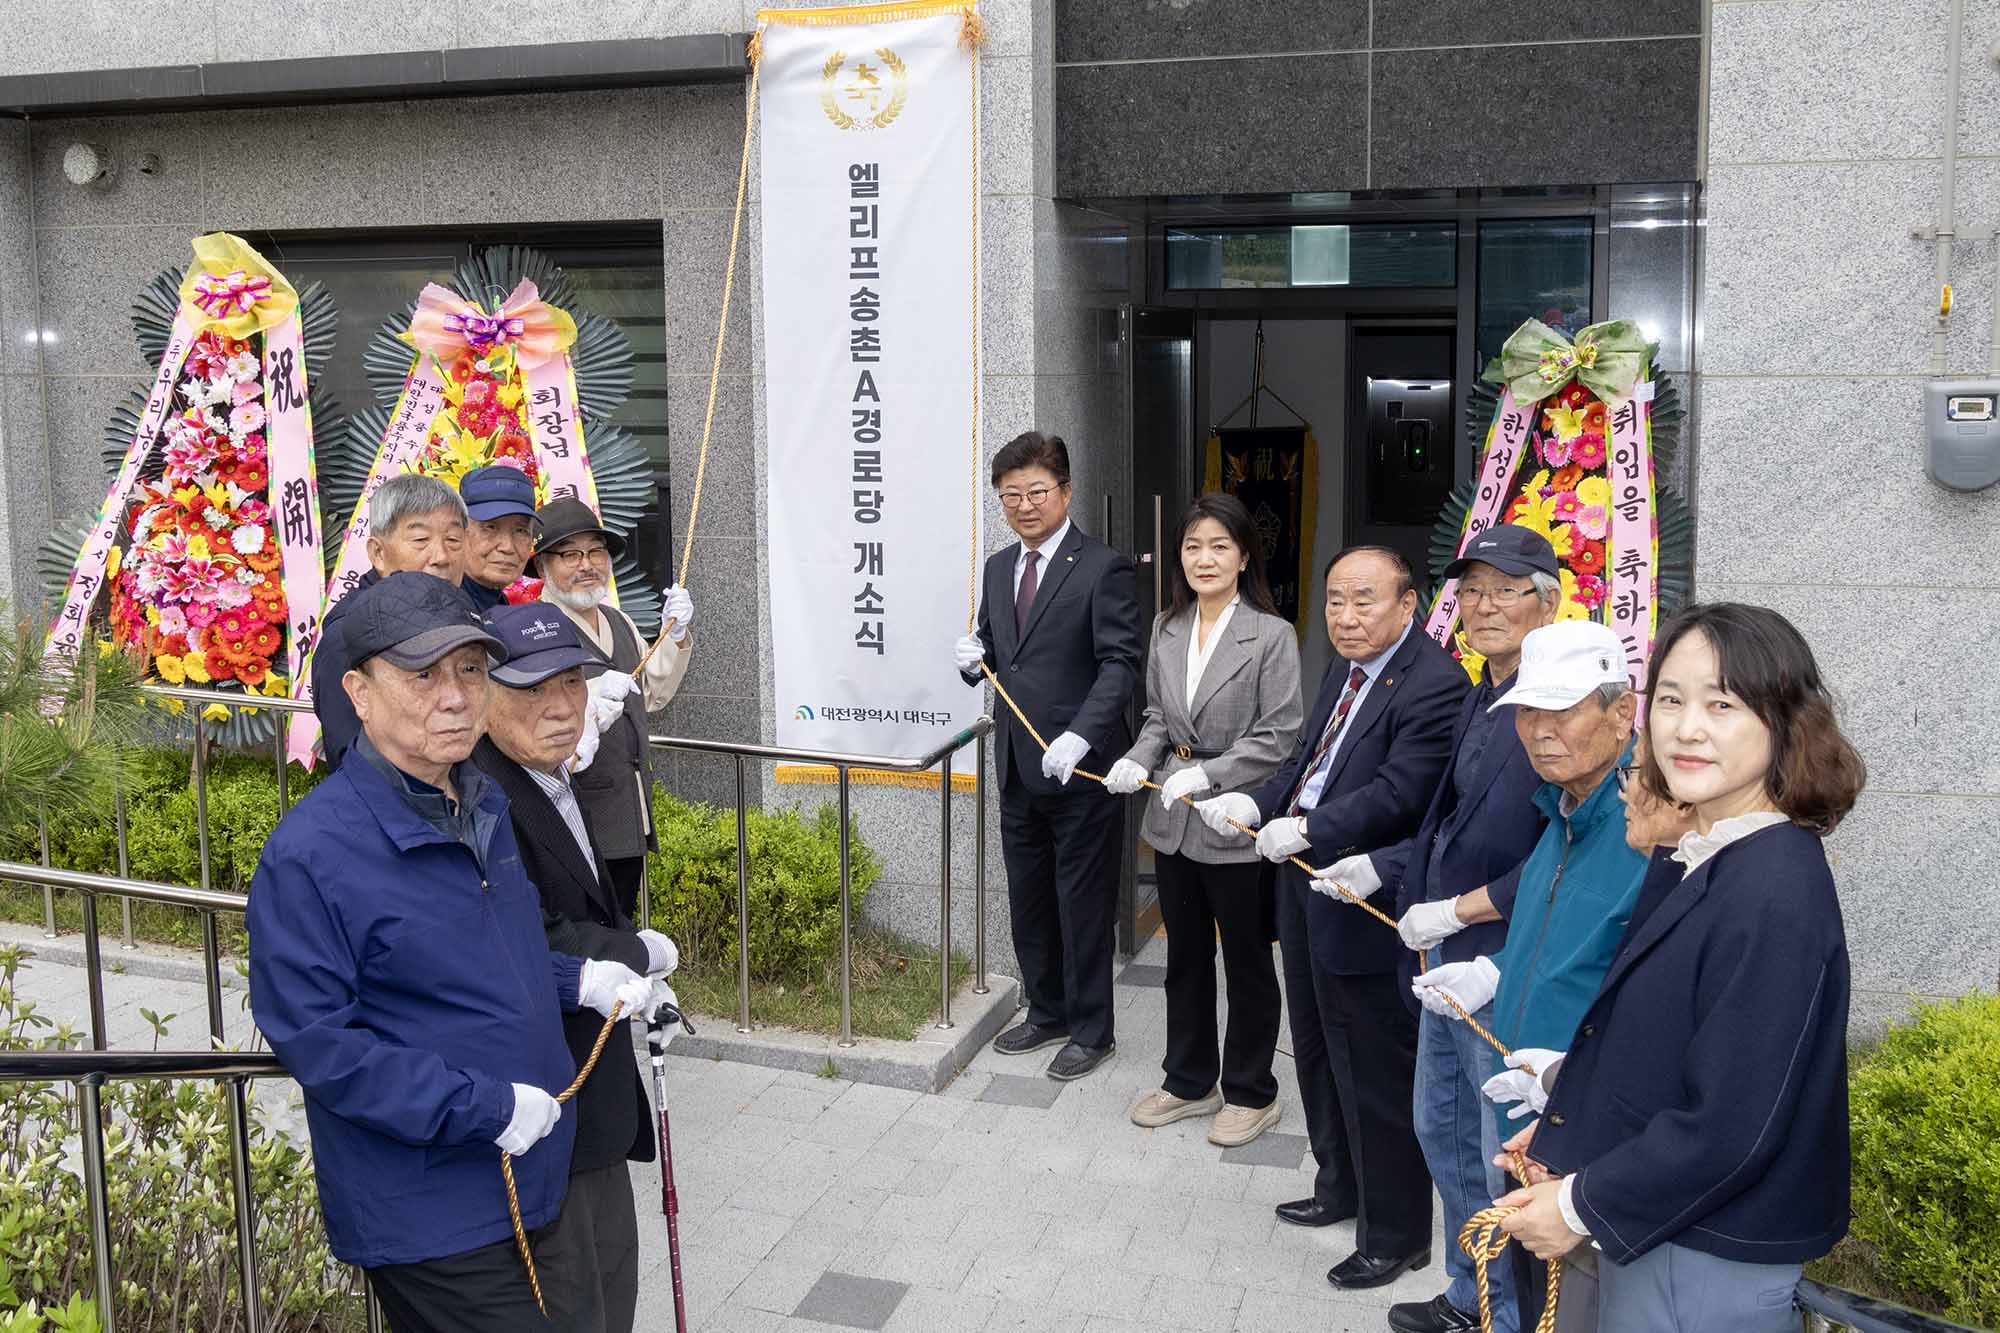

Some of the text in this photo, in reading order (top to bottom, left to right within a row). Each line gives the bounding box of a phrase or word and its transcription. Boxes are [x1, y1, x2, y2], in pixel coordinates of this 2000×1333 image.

[843, 63, 881, 112] 축
[532, 386, 569, 458] 회장님
[848, 162, 885, 655] 엘리프송촌A경로당 개소식
[1612, 400, 1647, 522] 취임을
[821, 705, 951, 726] 대전광역시 대덕구
